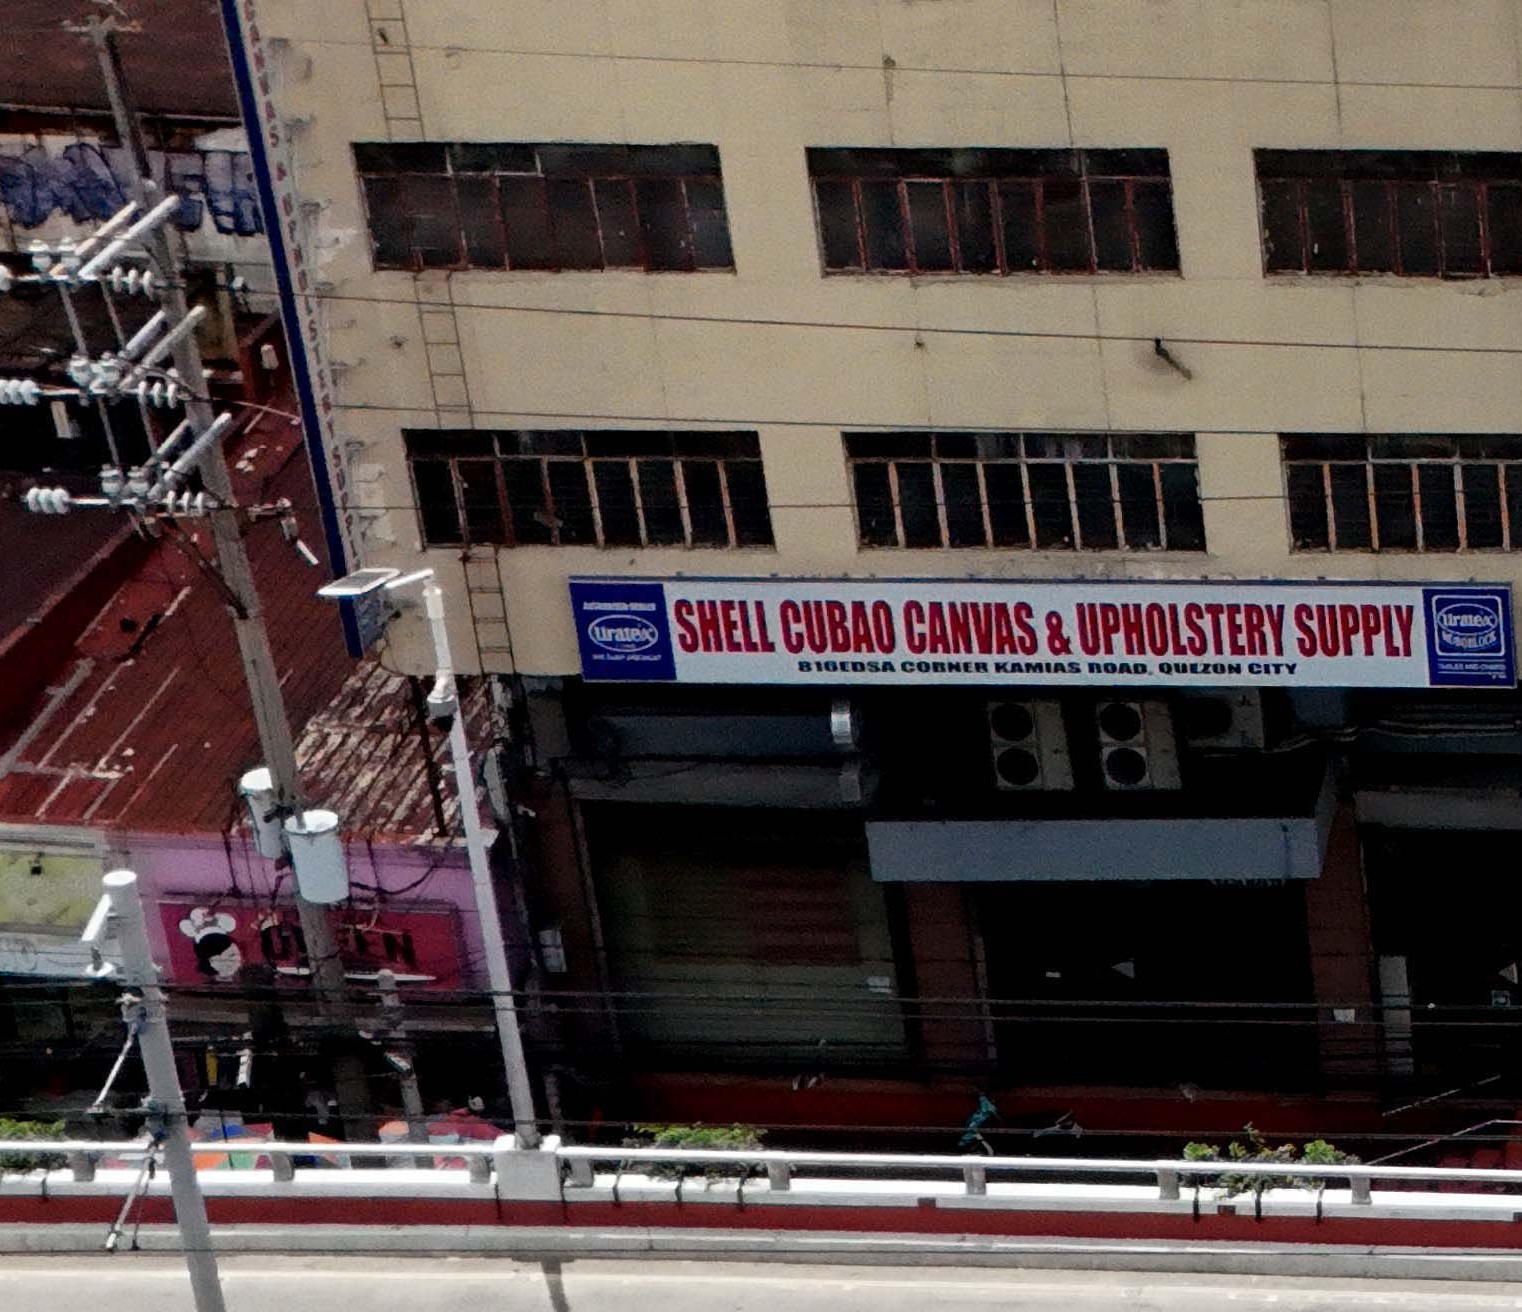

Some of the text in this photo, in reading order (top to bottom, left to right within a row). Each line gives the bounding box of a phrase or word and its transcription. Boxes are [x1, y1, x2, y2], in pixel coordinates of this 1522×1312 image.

[674, 599, 1414, 657] SHELL CUBAO CANVAS & UPHOLSTERY SUPPLY
[901, 660, 988, 673] CORNER
[994, 661, 1081, 674] KAMIAS
[1158, 662, 1242, 675] QUEZON
[1247, 662, 1298, 675] CITY
